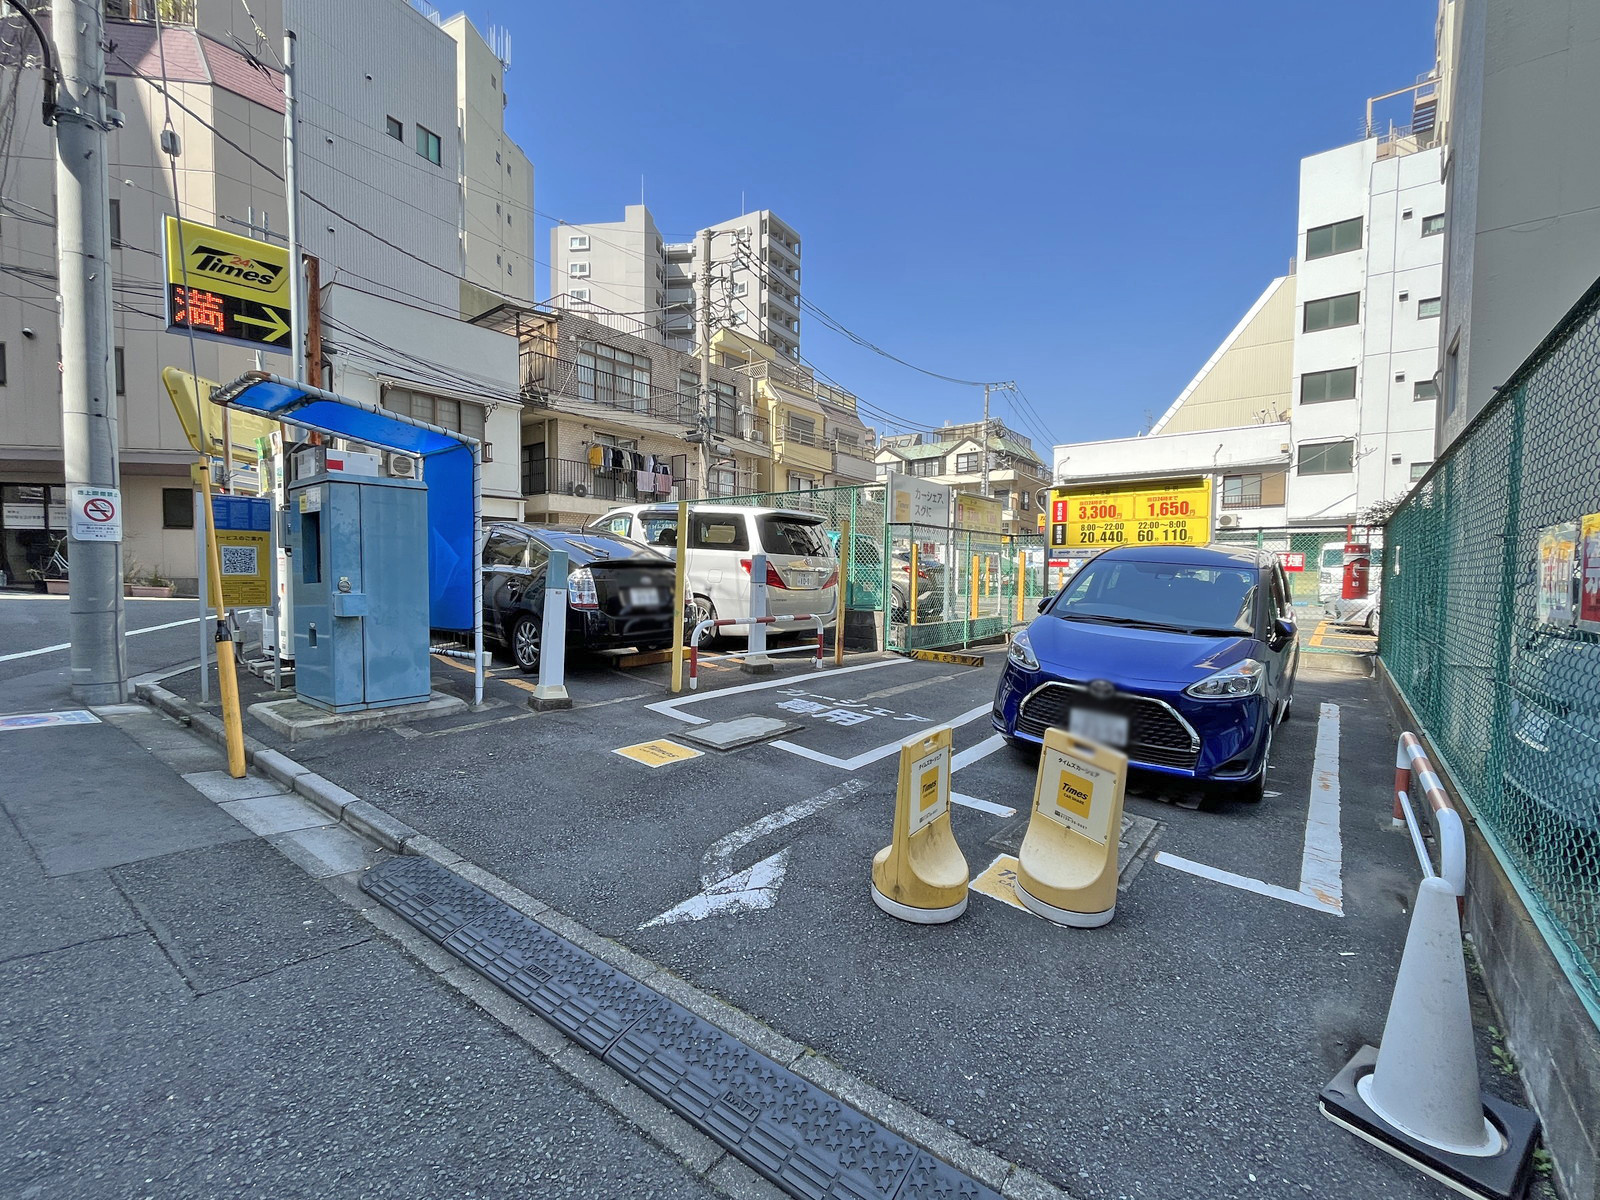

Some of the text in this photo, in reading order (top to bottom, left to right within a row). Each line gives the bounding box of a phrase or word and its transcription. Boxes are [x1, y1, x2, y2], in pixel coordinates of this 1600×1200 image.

[191, 245, 275, 285] Times
[175, 287, 224, 332] 満
[775, 698, 874, 726] 専用
[777, 689, 935, 722] カーシェア
[922, 780, 937, 793] Times
[1062, 782, 1089, 800] Times
[1063, 792, 1072, 800] CAR
